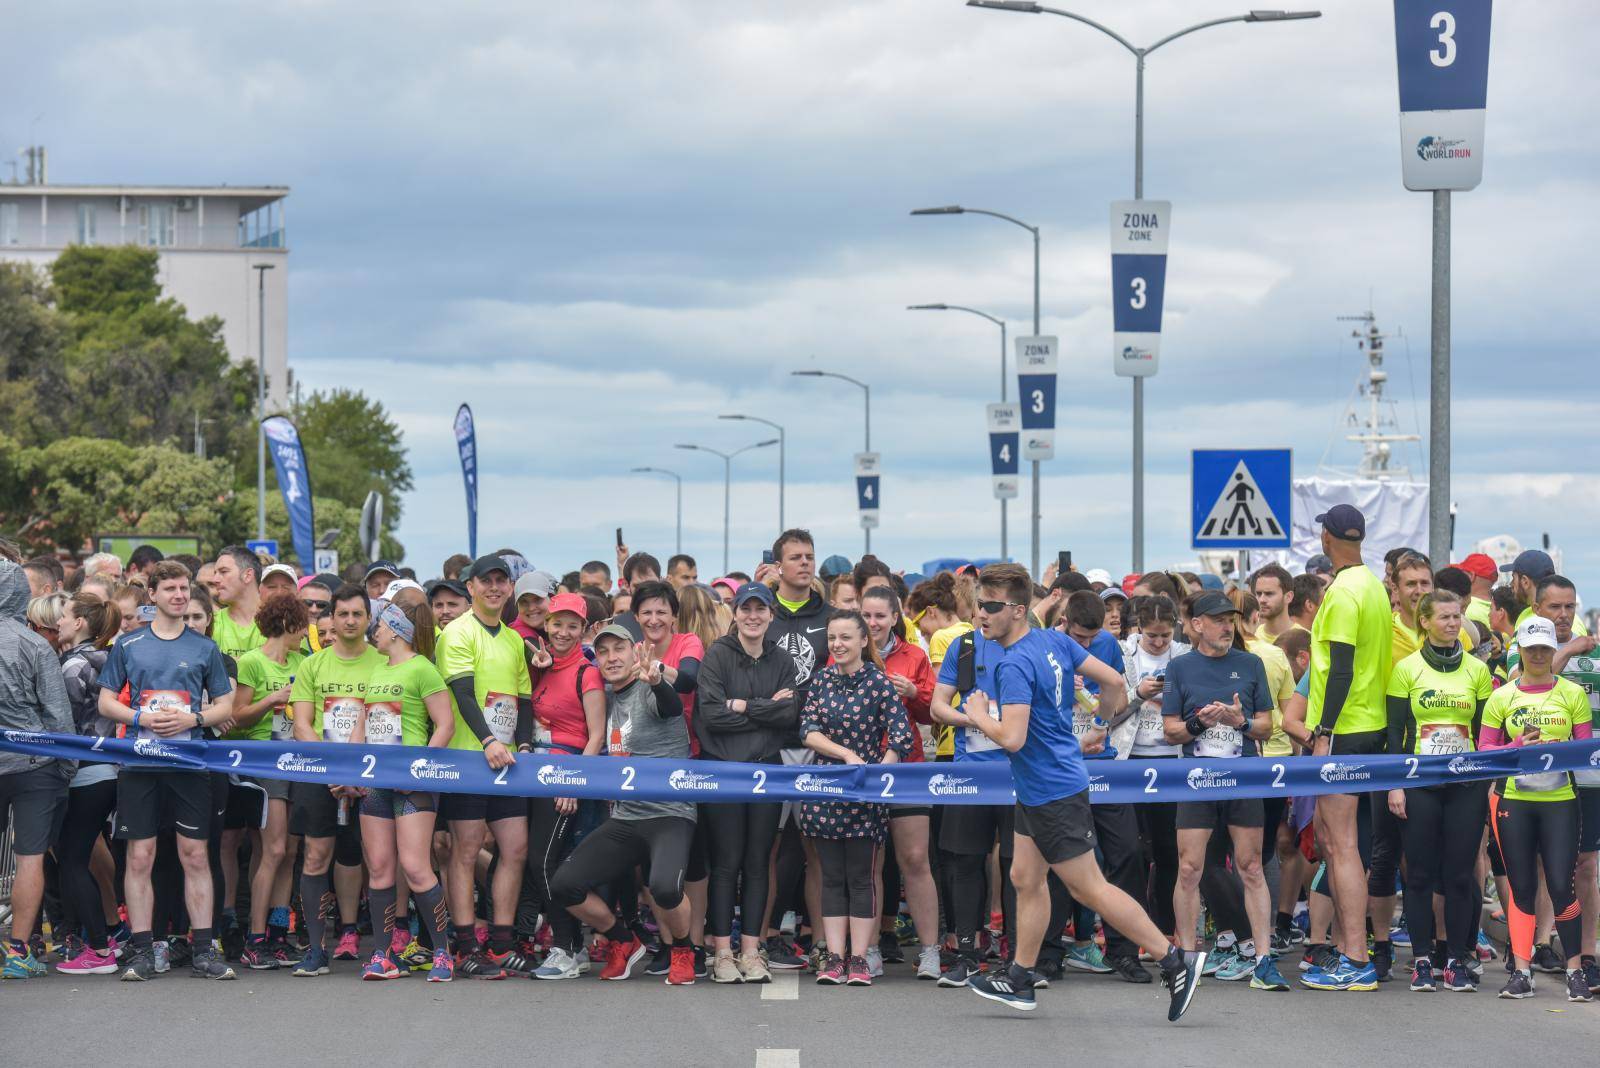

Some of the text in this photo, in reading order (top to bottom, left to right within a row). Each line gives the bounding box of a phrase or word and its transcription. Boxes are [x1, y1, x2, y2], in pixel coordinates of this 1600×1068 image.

[1430, 11, 1457, 67] 3
[1123, 213, 1159, 228] ZONA
[1128, 230, 1152, 241] ZONE
[1130, 277, 1147, 309] 3
[1024, 345, 1050, 356] ZONA
[1032, 389, 1045, 413] 3
[999, 443, 1011, 463] 4
[864, 484, 874, 500] 4
[321, 682, 353, 693] LET'S
[361, 754, 376, 778] 2
[494, 766, 507, 785] 2
[1271, 763, 1286, 788] 2
[1405, 757, 1419, 779] 2
[621, 766, 636, 791] 2
[752, 770, 767, 794] 2
[880, 773, 895, 798] 2
[1144, 768, 1158, 793] 2
